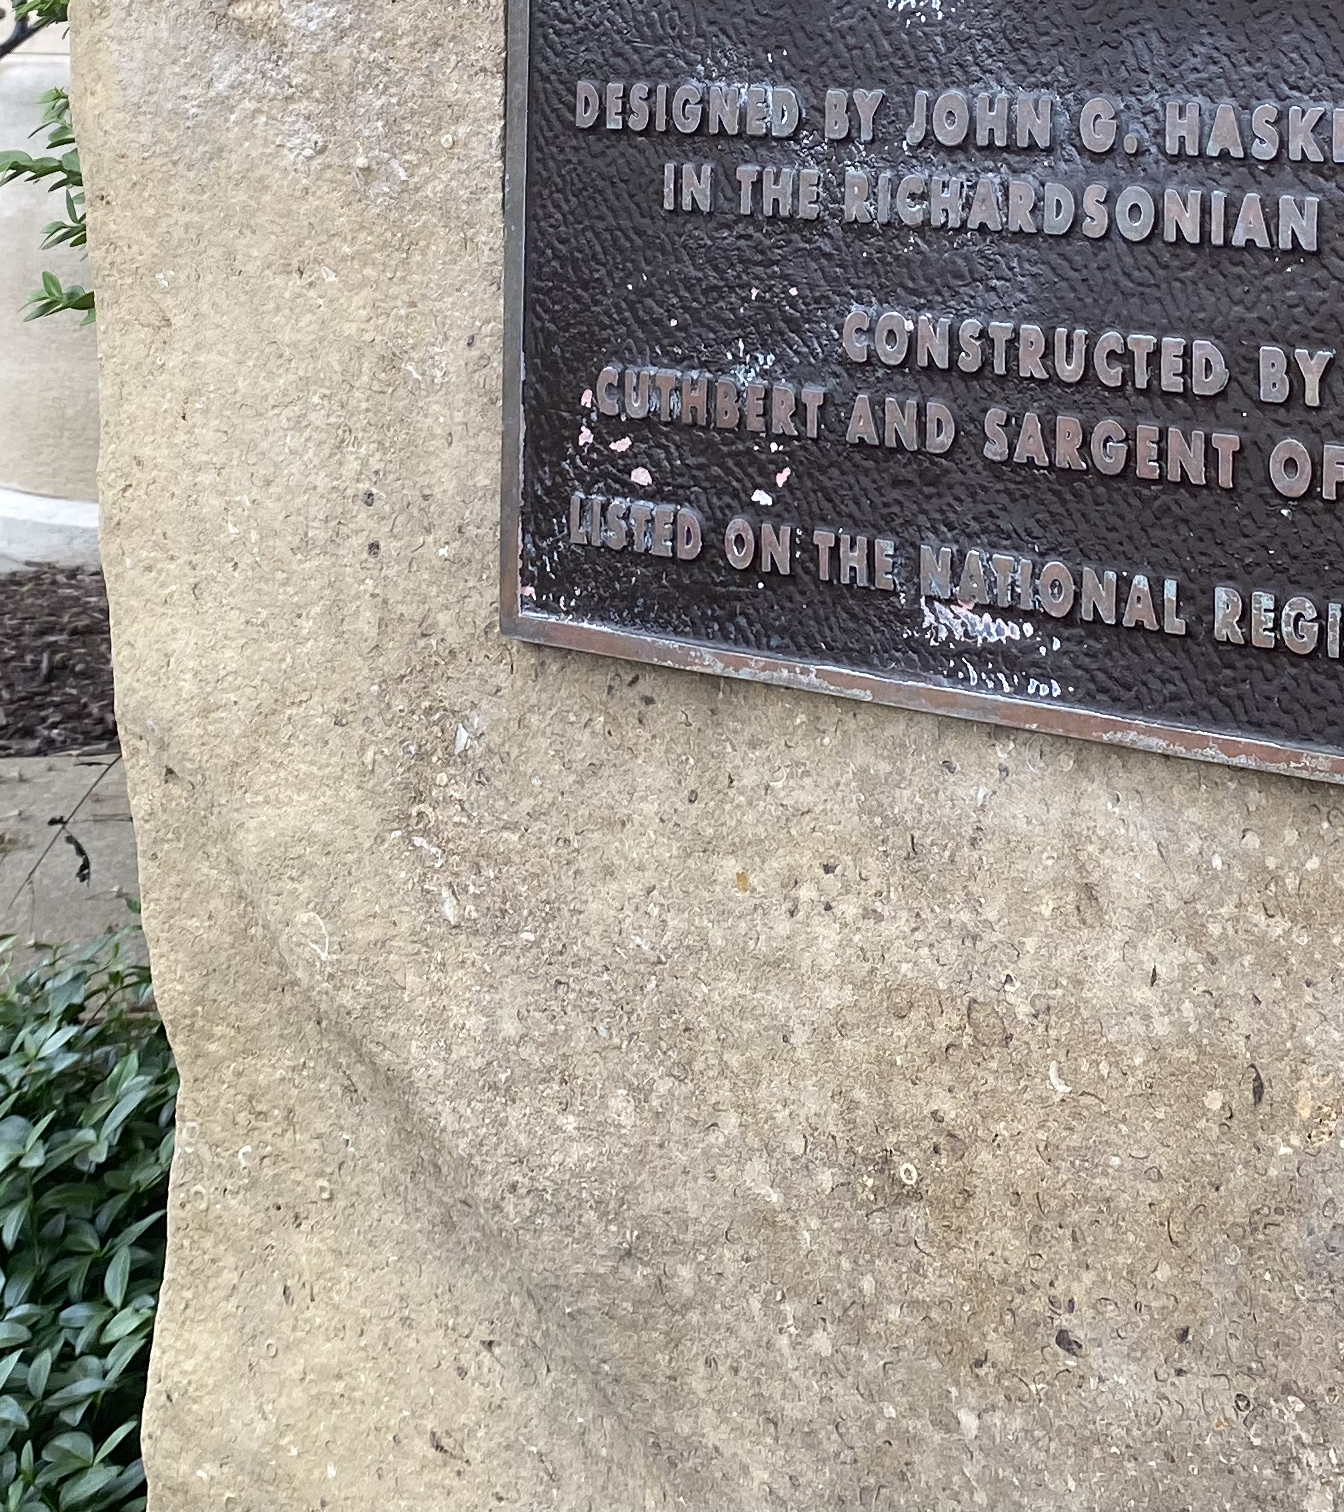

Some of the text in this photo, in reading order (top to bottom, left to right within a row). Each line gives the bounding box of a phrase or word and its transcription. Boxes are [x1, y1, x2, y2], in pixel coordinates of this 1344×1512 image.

[575, 80, 800, 139] DESIGNED
[824, 88, 885, 142] BY
[906, 89, 1052, 147] JOHN
[1079, 97, 1140, 155] G.
[663, 162, 712, 212] IN
[736, 165, 822, 221] THE
[843, 170, 1320, 252] RICHARDSONIAN
[842, 310, 1230, 397] CONSTRUCTED
[1259, 346, 1335, 408] BY
[595, 366, 825, 439] CUTHBERT
[846, 394, 955, 455] AND
[983, 408, 1241, 489] SARGENT
[569, 492, 703, 562] LISTED
[724, 518, 792, 576] ON
[812, 530, 896, 591] THE
[919, 544, 1186, 636] NATIONAL
